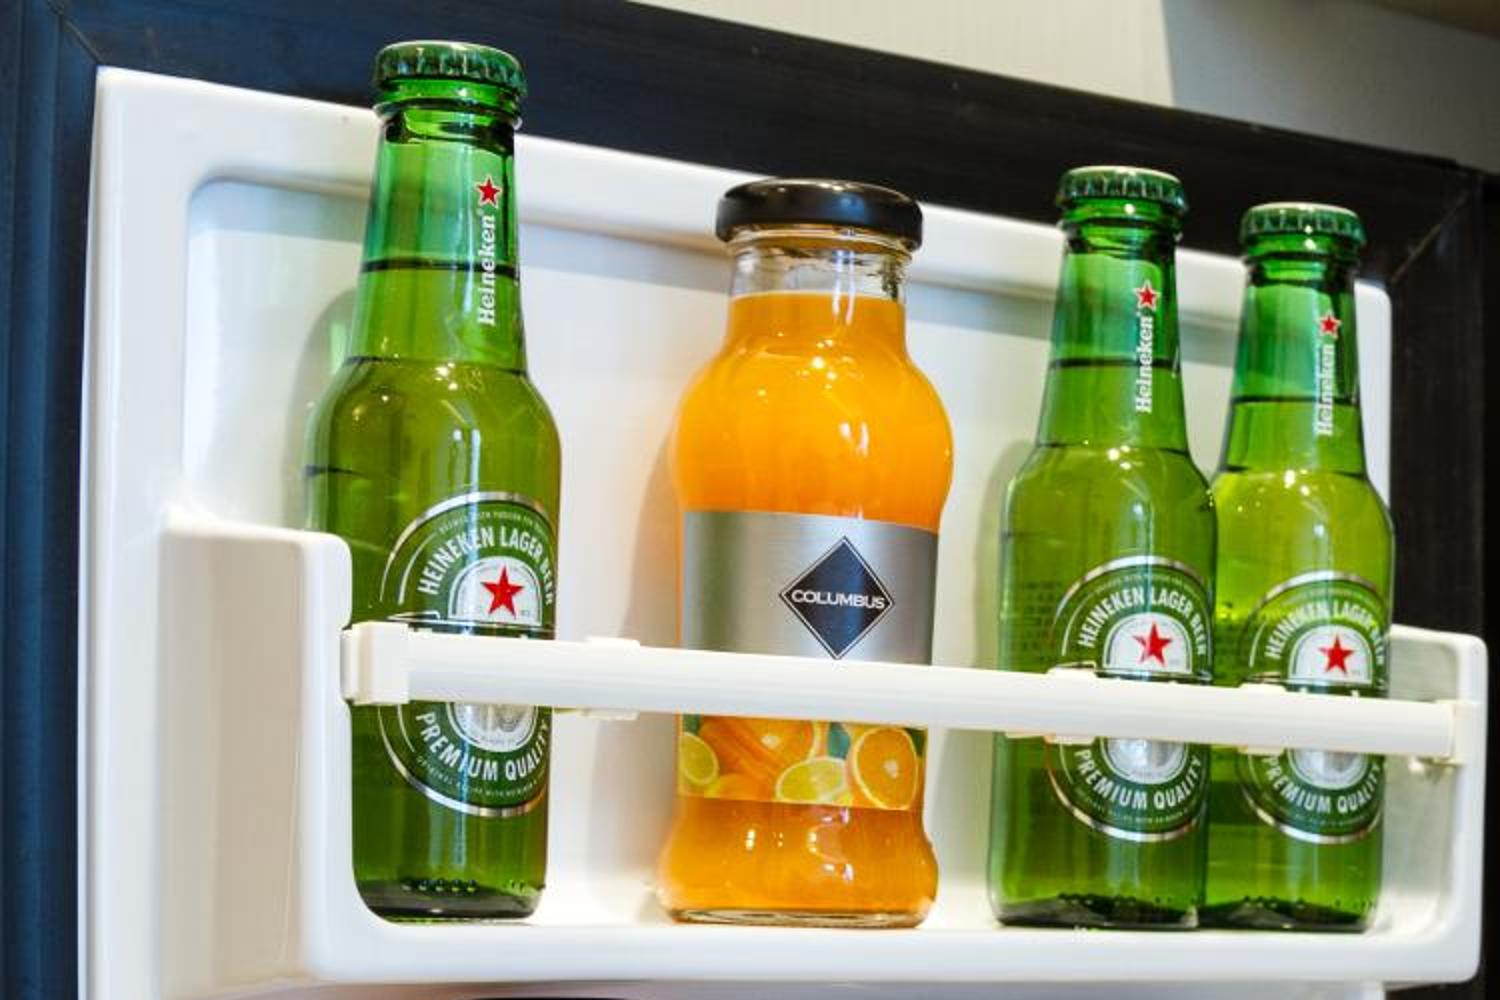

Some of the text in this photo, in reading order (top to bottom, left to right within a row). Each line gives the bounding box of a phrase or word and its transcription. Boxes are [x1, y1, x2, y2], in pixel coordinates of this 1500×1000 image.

[477, 214, 496, 326] Heineken
[1135, 315, 1153, 413] Heineken
[1314, 343, 1335, 437] Heineken
[417, 527, 495, 596] HEINEKEN
[501, 525, 544, 559] LAGER
[790, 588, 886, 610] COLUMBUS
[1077, 586, 1146, 649] HEINEKEN
[1151, 586, 1194, 619] LAGER
[1264, 599, 1330, 660] HEINEKEN
[416, 711, 498, 782] PREMIUM
[505, 718, 550, 782] QUALITY
[1074, 749, 1148, 811] PREMIUM
[1153, 756, 1202, 811] QUALITY
[1263, 755, 1331, 814] PREMIUM
